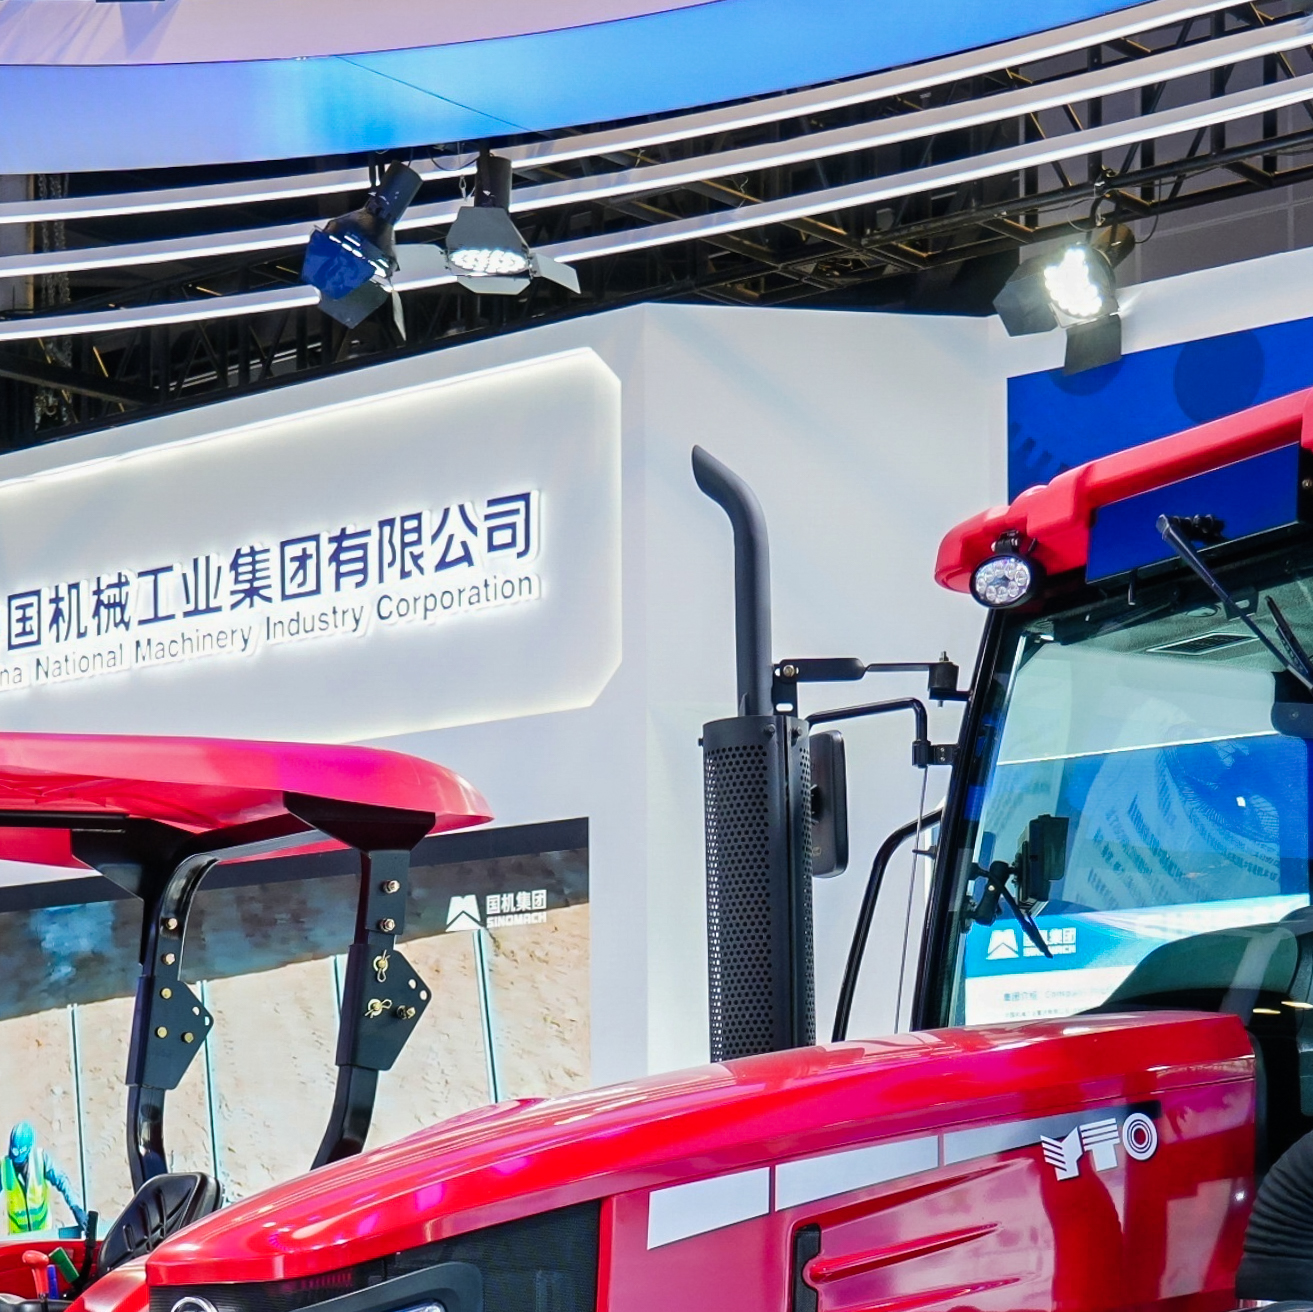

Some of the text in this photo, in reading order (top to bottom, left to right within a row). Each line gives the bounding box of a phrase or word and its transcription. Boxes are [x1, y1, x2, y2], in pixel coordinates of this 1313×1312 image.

[34, 641, 126, 681] National
[134, 623, 253, 665] Machinery
[264, 602, 365, 645] Industry
[375, 574, 533, 623] Corporation
[486, 889, 548, 915] 国机集团
[486, 911, 547, 928] SINOMACH
[1041, 1111, 1160, 1182] YTO
